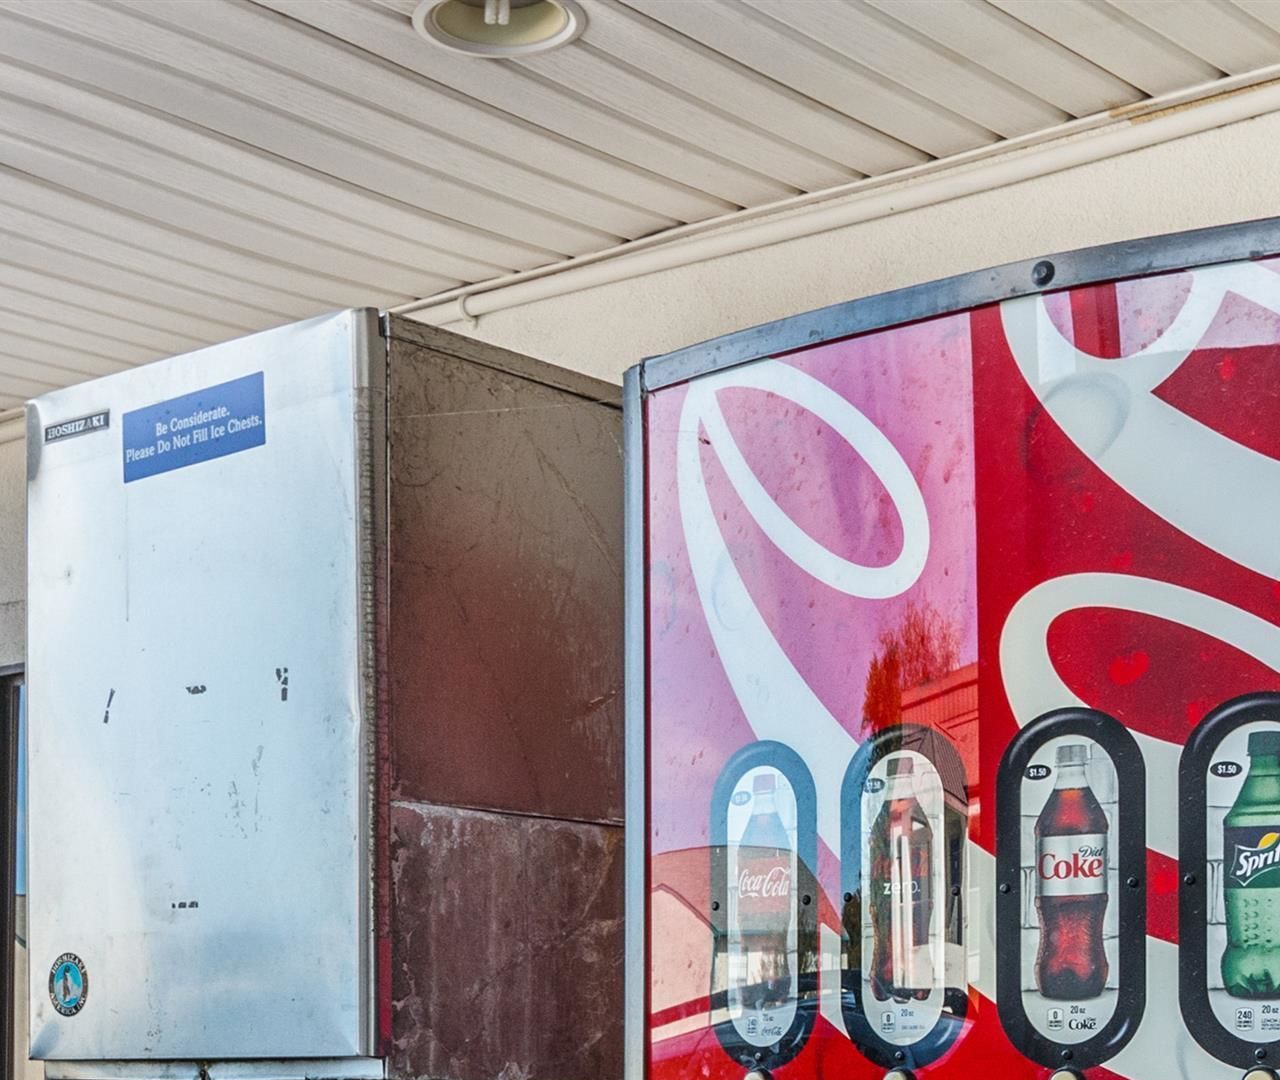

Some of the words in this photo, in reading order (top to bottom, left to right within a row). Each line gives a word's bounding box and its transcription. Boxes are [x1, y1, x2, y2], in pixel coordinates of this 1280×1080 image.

[47, 415, 105, 439] HOSHIZAKI
[155, 422, 168, 437] Be
[170, 405, 230, 432] Considerate.
[125, 446, 155, 463] Please
[157, 440, 170, 454] Do
[173, 435, 191, 450] Not
[192, 427, 208, 444] Fill
[210, 425, 225, 439] Ice
[227, 415, 263, 434] Chests.
[1029, 768, 1047, 777] $1.50
[1217, 764, 1237, 774] $1.50
[1079, 844, 1103, 858] Diet
[1038, 853, 1104, 880] Coke
[739, 866, 791, 898] Coca-Cola
[1070, 1005, 1078, 1014] 20
[1237, 1010, 1252, 1020] 240
[1261, 1004, 1271, 1014] 20
[1068, 1018, 1097, 1030] Coke
